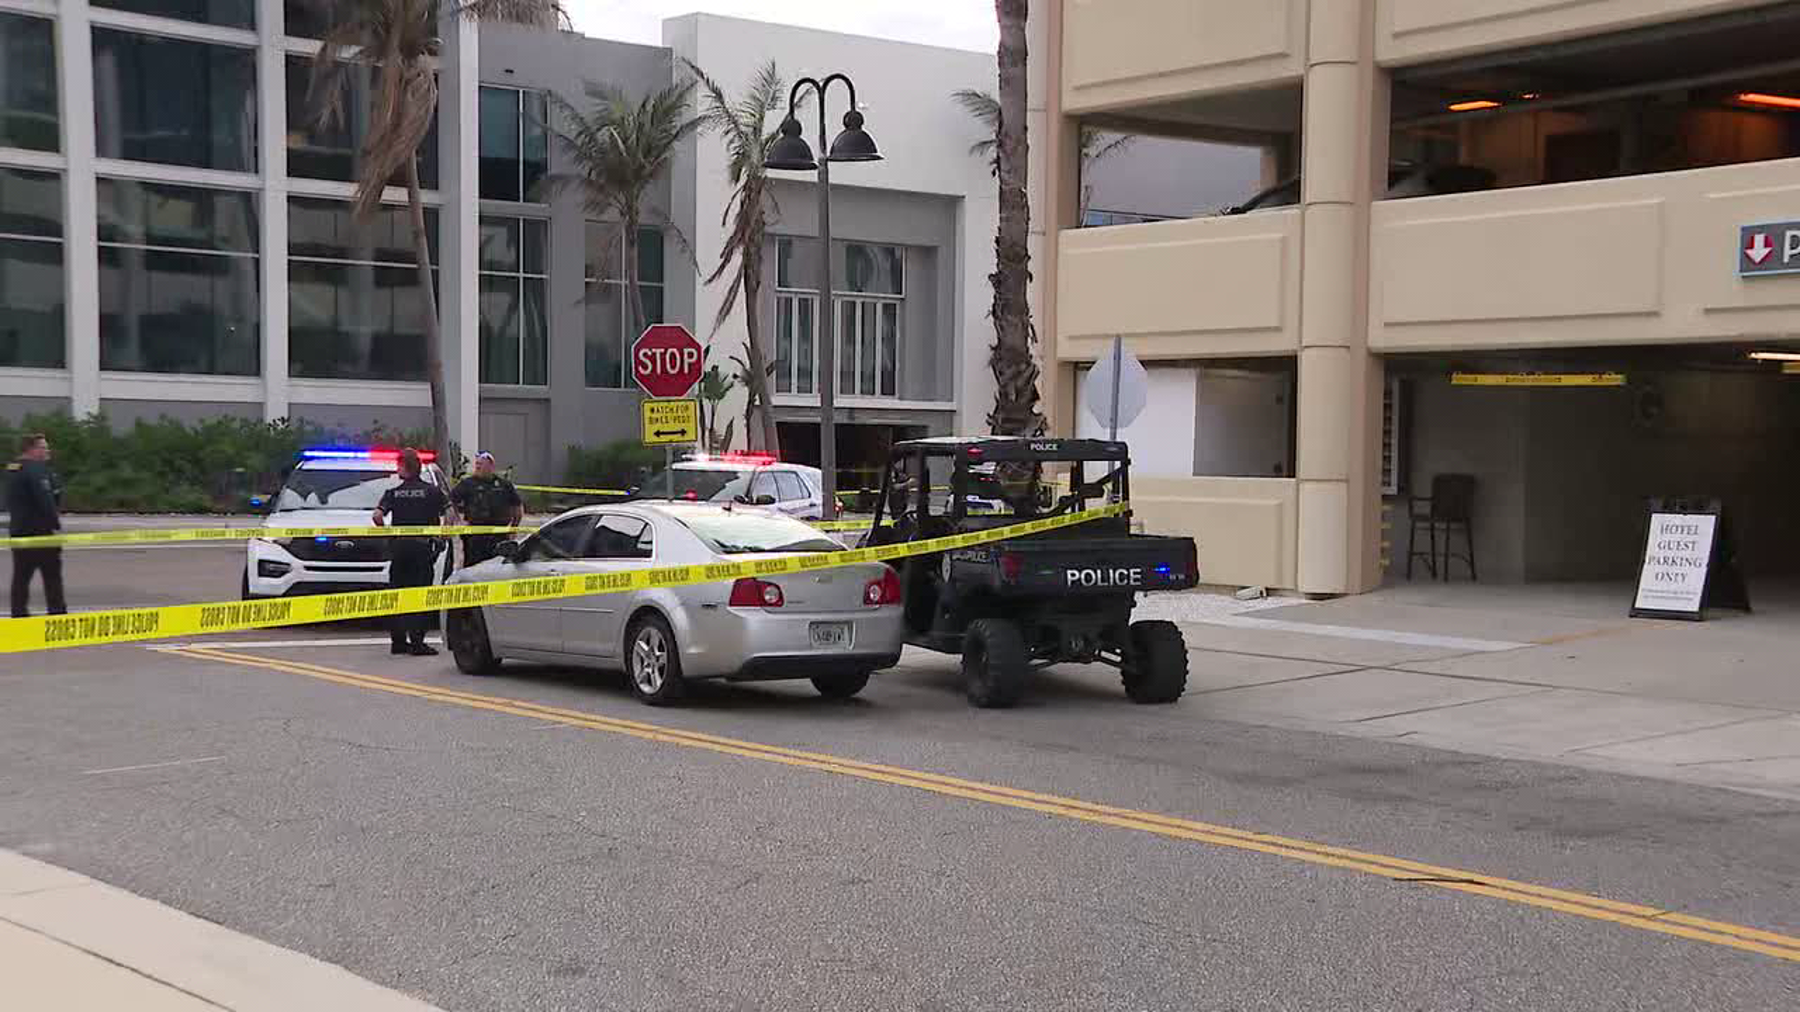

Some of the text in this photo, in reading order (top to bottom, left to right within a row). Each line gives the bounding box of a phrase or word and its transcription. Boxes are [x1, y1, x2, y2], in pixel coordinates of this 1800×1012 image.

[638, 347, 698, 375] STOP
[1030, 443, 1058, 451] POLICE
[1660, 523, 1699, 535] HOTEL
[1657, 540, 1697, 551] GUEST
[1648, 556, 1703, 568] PARKING
[1066, 568, 1142, 586] POLICE
[1654, 572, 1688, 583] ONLY
